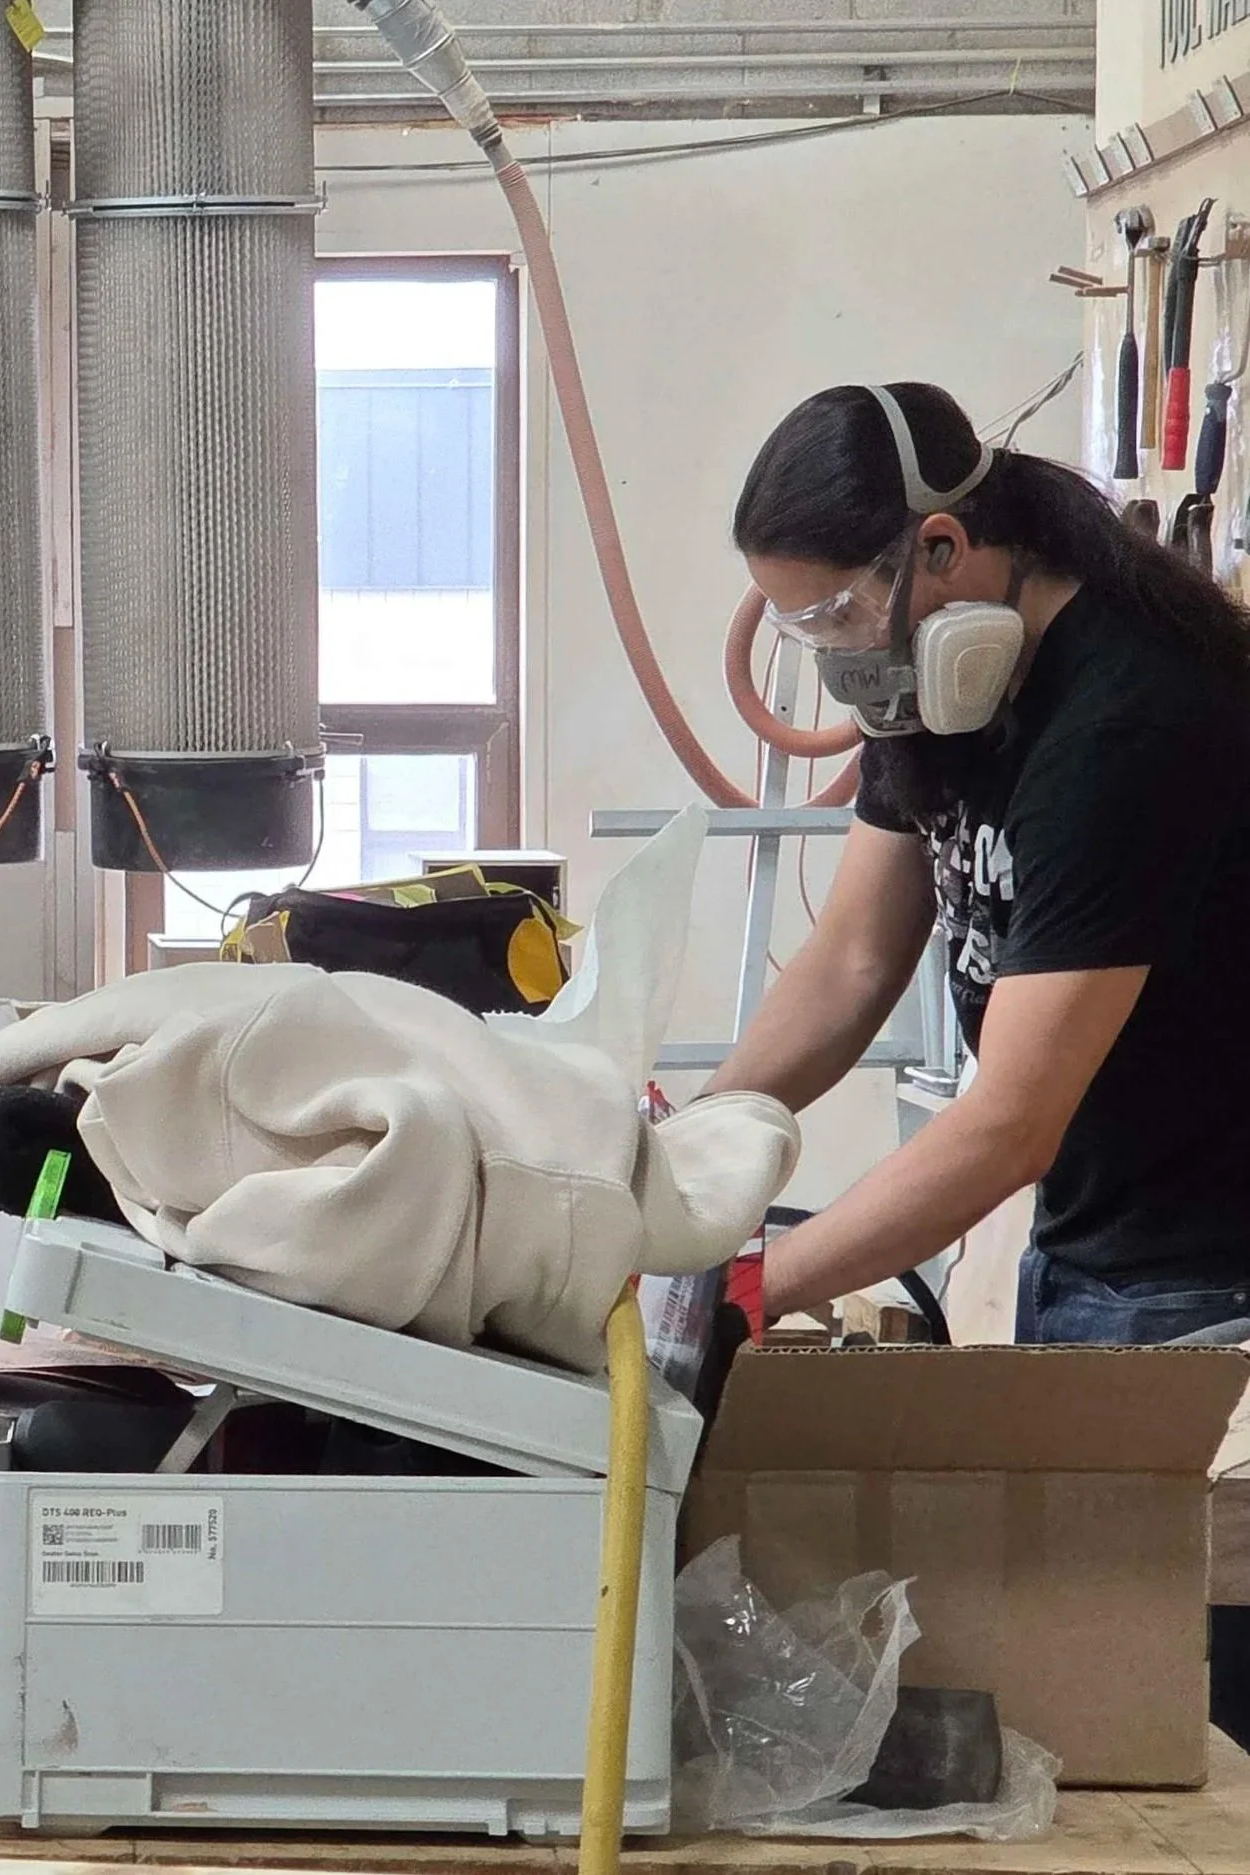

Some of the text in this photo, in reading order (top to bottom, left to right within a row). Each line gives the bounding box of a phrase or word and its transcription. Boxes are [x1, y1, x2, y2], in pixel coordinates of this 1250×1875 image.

[840, 663, 880, 693] MW
[42, 1508, 61, 1517] DTS
[63, 1508, 81, 1517] 400
